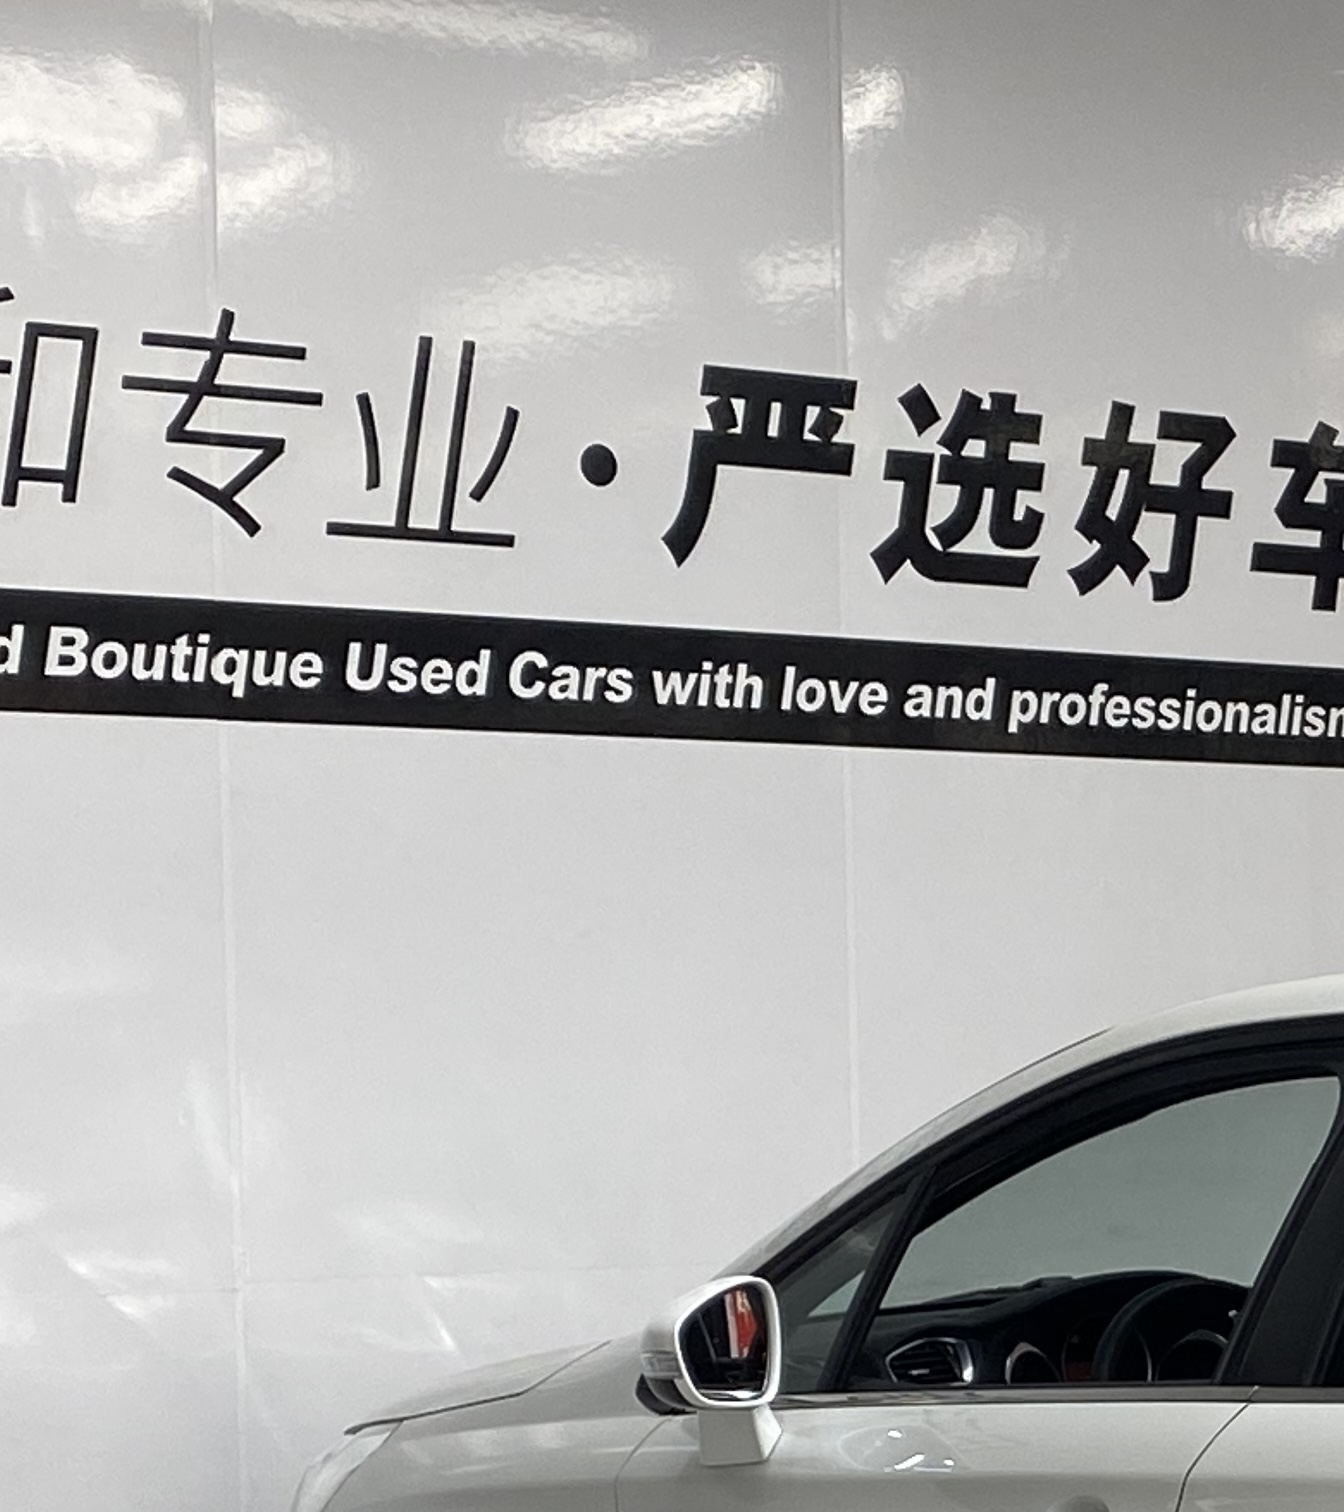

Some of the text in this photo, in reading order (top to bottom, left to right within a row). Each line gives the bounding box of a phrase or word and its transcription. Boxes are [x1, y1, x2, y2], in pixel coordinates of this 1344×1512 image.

[44, 625, 324, 698] Boutique
[345, 641, 491, 696] Used
[509, 651, 634, 703] Cars
[652, 661, 763, 709] with
[780, 665, 889, 715] love
[903, 677, 996, 721] and
